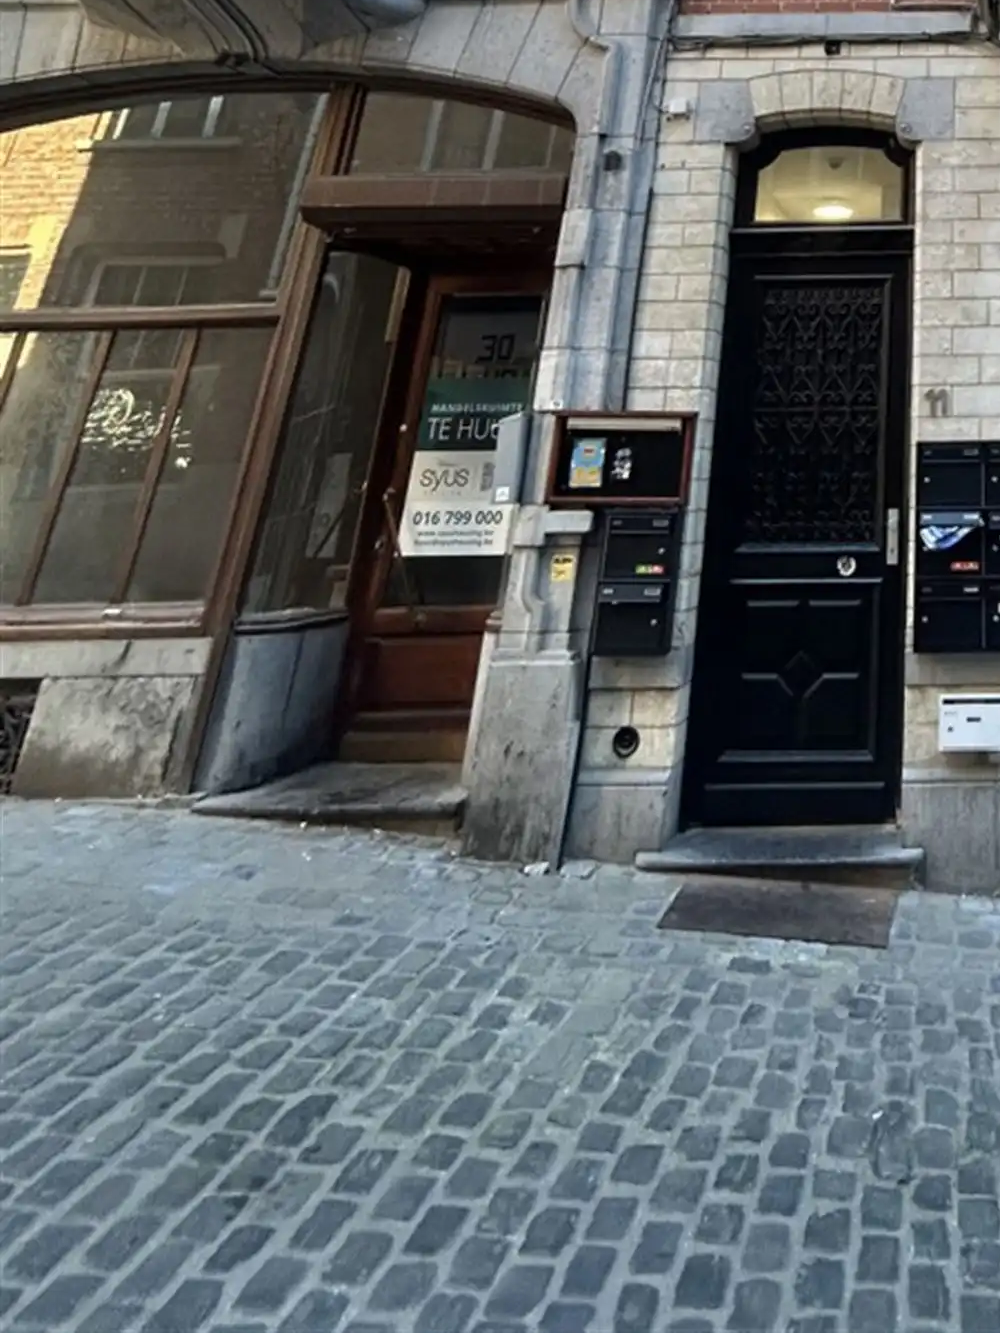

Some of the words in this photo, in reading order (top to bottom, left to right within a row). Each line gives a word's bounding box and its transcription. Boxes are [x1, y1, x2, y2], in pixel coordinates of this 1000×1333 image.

[428, 417, 453, 440] TE
[412, 510, 441, 526] 016
[444, 510, 472, 526] 799
[474, 510, 503, 525] 000
